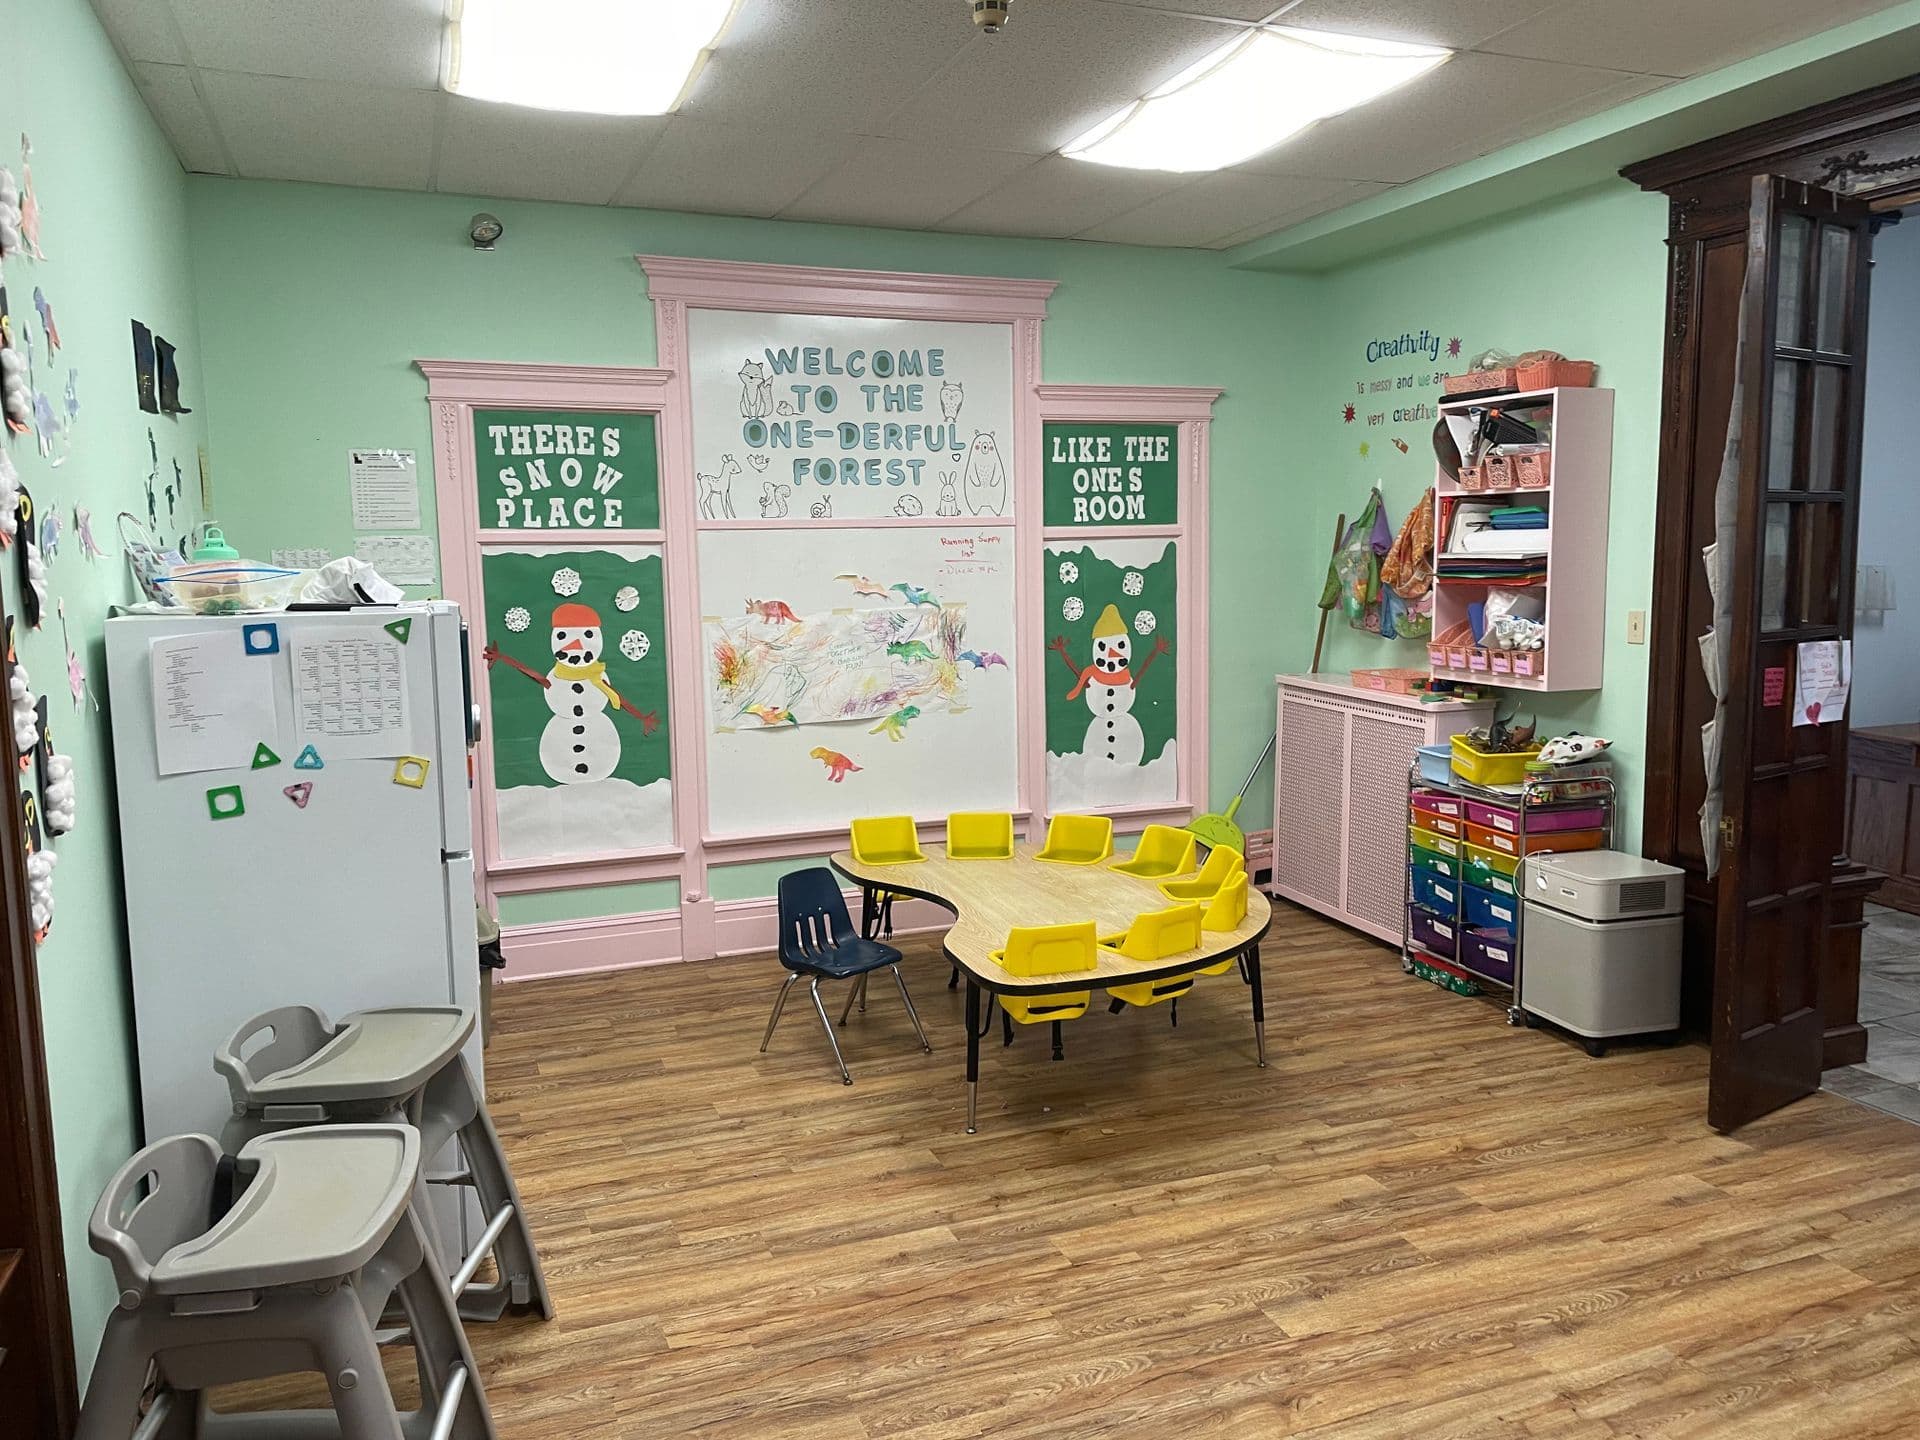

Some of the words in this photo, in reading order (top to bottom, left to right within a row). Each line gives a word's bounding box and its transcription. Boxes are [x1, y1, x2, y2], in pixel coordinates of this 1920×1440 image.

[1366, 330, 1440, 363] Creativity
[765, 346, 945, 378] WELCOME
[791, 384, 838, 413] TO
[860, 384, 924, 412] THE
[1357, 381, 1365, 395] is
[1370, 378, 1393, 394] messy
[1396, 374, 1414, 390] and
[1418, 374, 1431, 387] we
[1367, 412, 1385, 426] very
[743, 418, 966, 452] ONE-DERFUL
[1052, 437, 1111, 463] LIKE
[1124, 436, 1169, 462] THE
[499, 457, 624, 498] SNOW
[793, 457, 926, 487] FOREST
[496, 497, 623, 528] PLACE
[1073, 494, 1146, 523] ROOM
